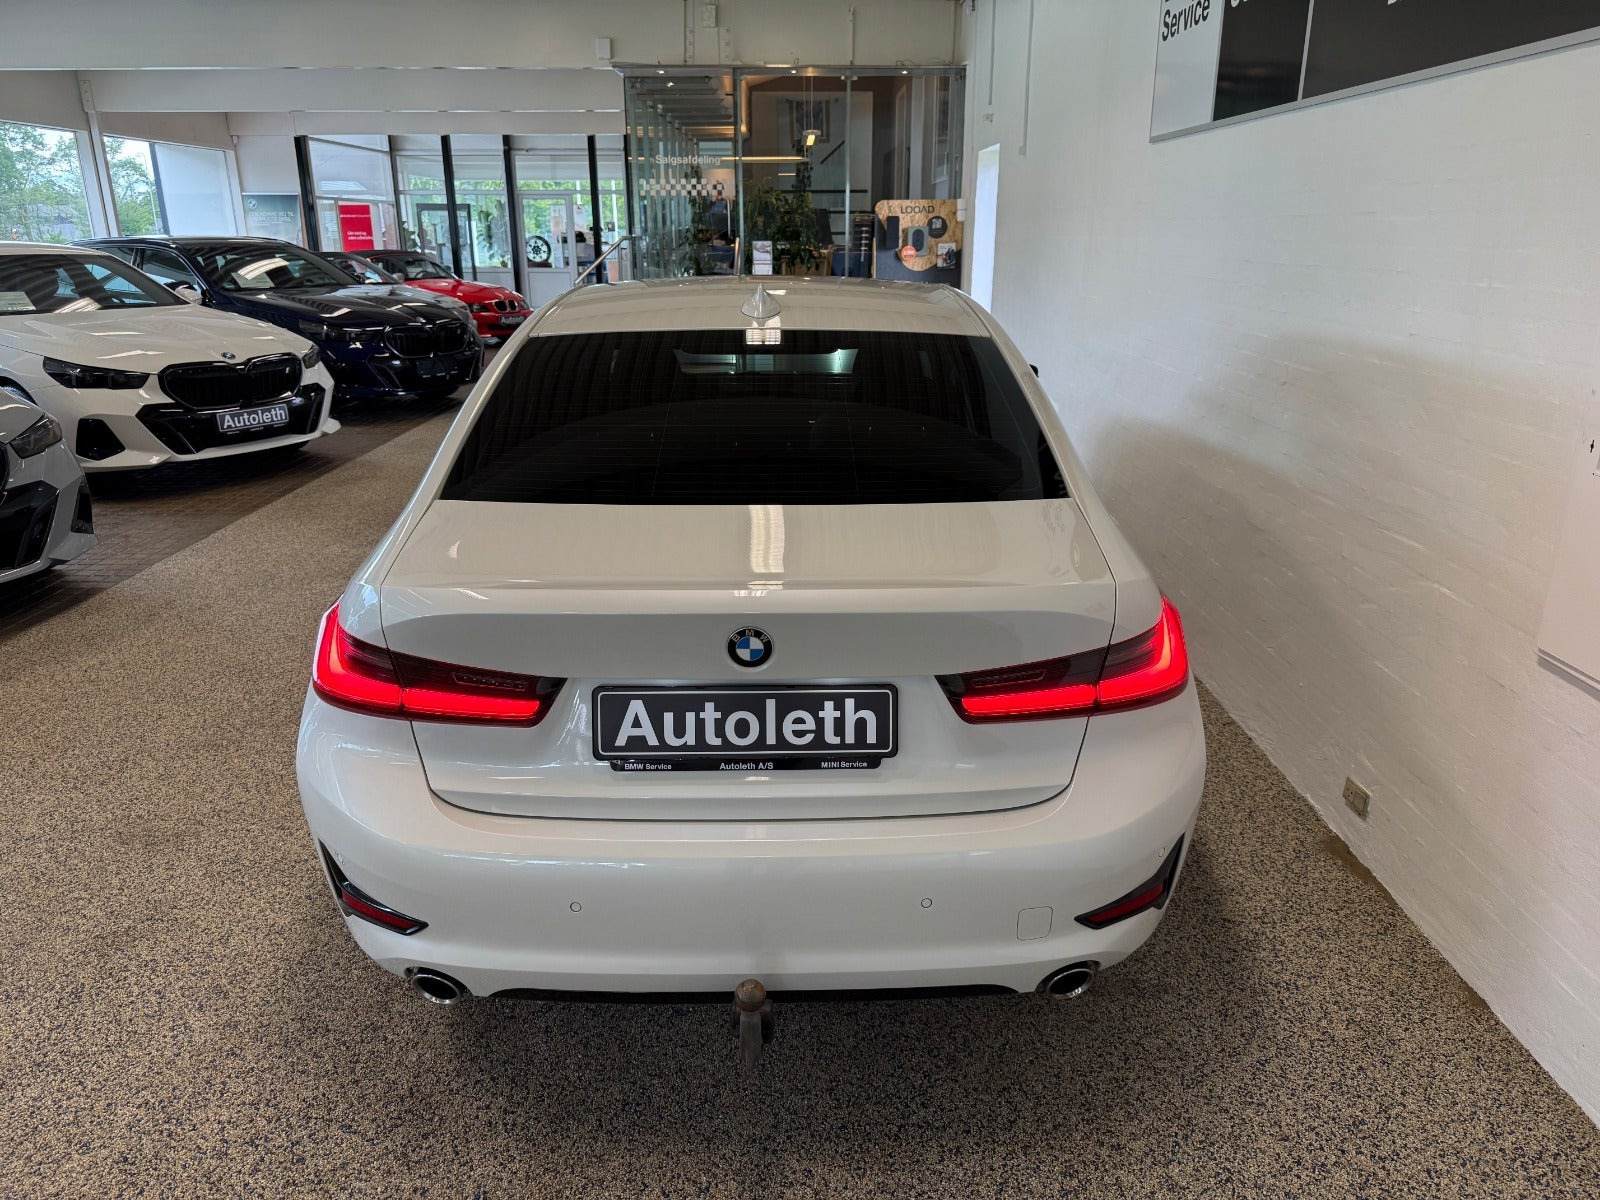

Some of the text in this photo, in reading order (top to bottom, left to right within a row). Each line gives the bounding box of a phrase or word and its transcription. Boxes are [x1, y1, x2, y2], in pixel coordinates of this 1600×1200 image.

[1162, 0, 1210, 41] Service
[655, 154, 721, 166] Salgsafdeling
[900, 205, 935, 214] LOOAD
[223, 407, 286, 429] Autoleth
[731, 629, 770, 643] BMW
[614, 698, 877, 747] Autoleth
[719, 762, 774, 770] Autoleth A/S
[821, 760, 868, 769] MINI Service
